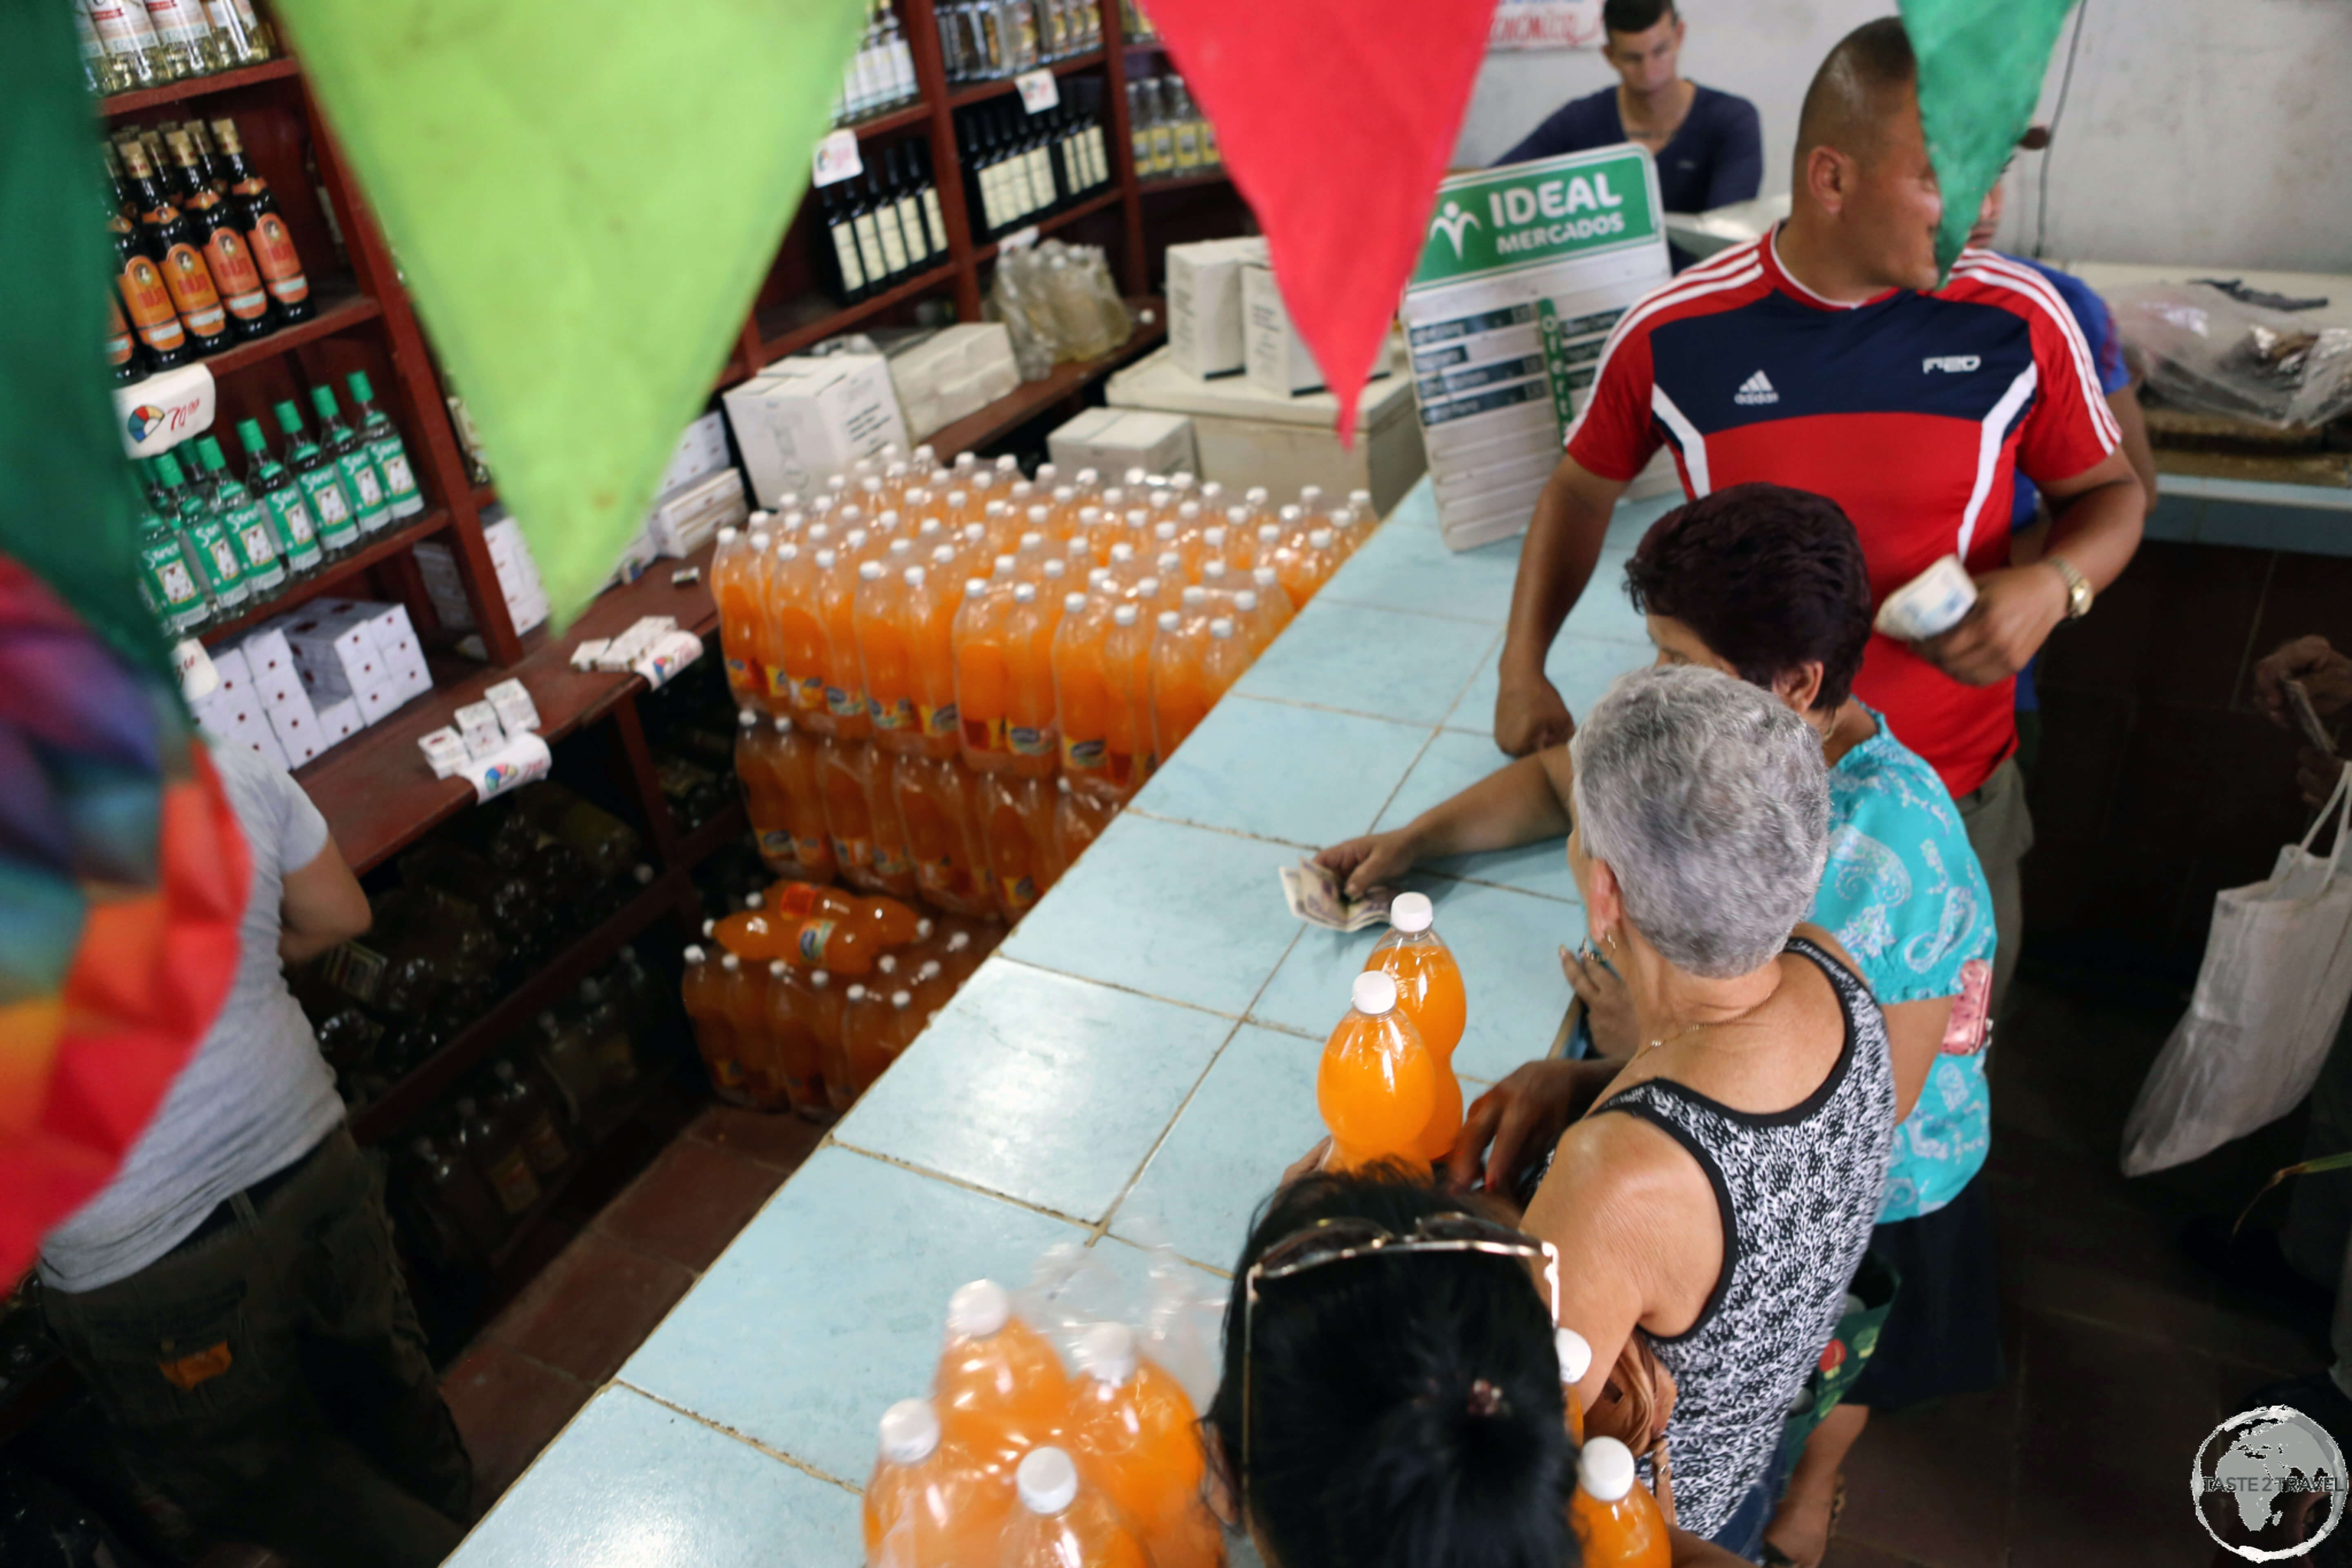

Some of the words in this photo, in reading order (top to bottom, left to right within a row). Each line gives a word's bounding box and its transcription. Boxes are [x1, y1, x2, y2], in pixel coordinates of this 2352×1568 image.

[1489, 172, 1623, 228] IDEAL
[1497, 212, 1625, 254] MERCADOS
[1734, 392, 1779, 405] adidas
